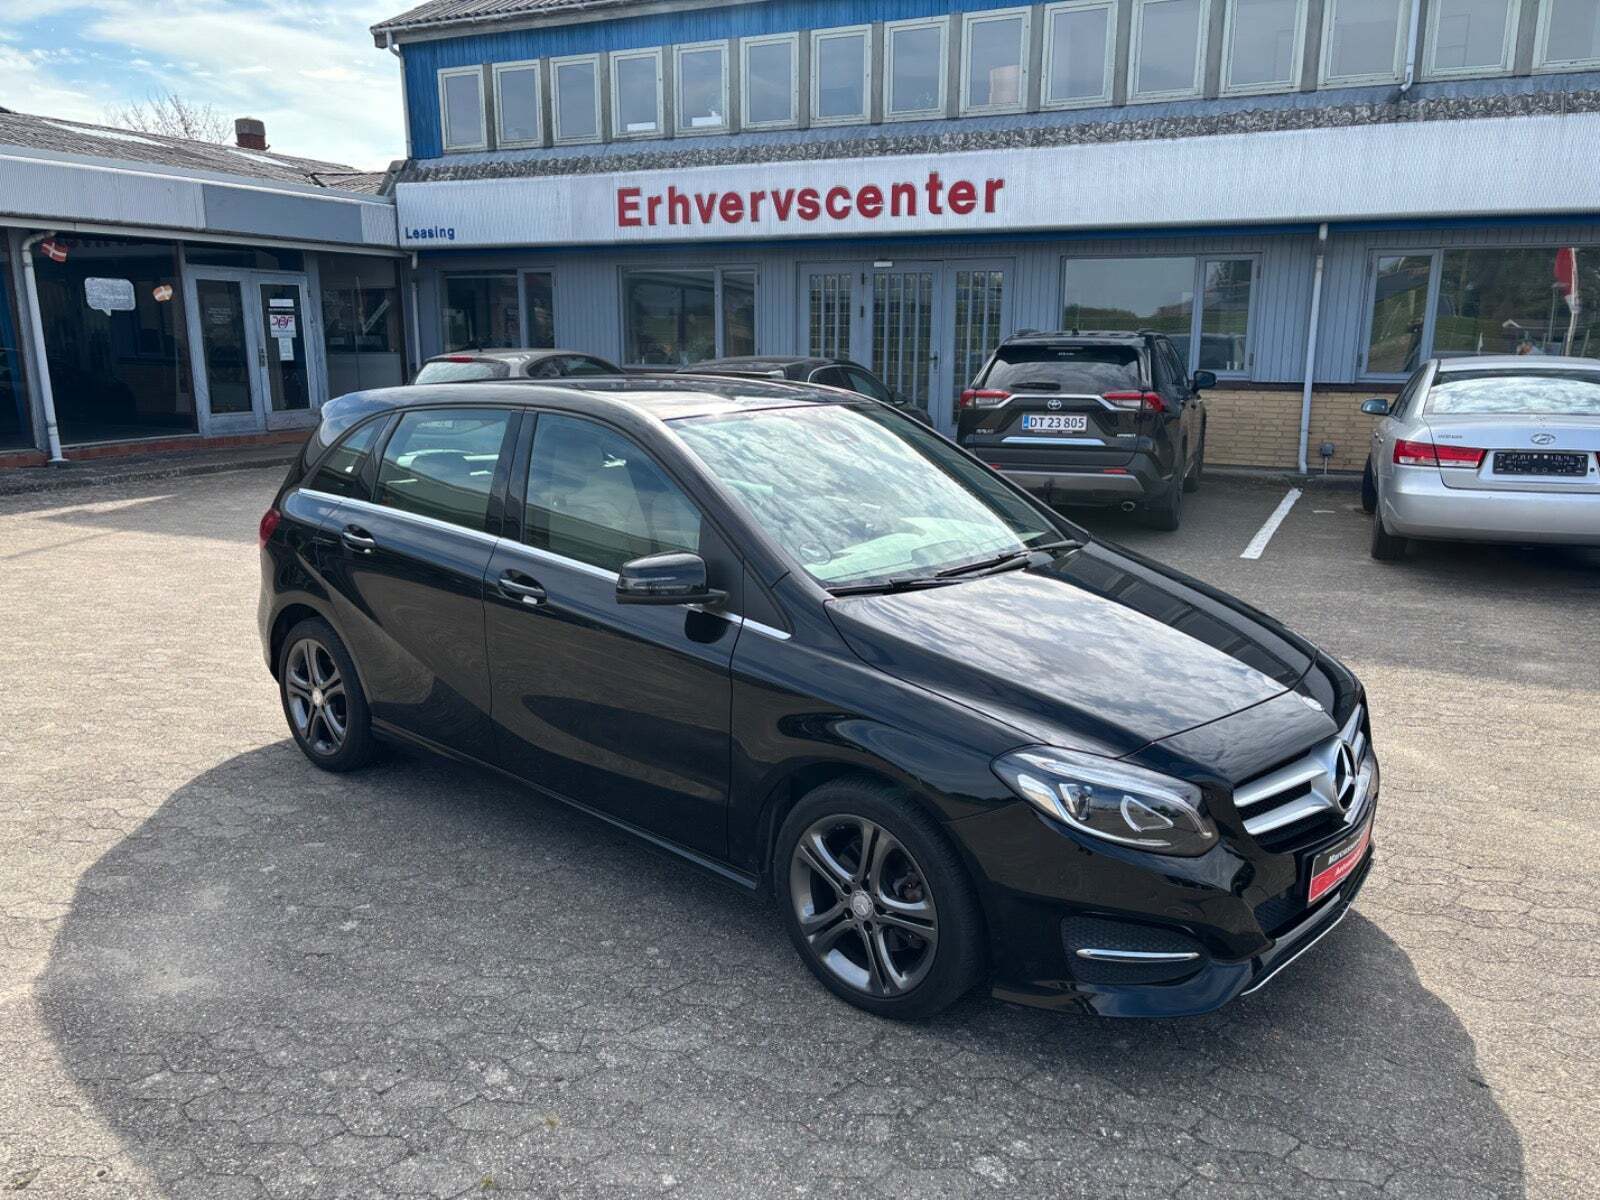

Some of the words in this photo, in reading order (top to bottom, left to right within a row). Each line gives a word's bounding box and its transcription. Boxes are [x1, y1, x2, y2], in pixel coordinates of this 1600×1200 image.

[617, 171, 1005, 227] Erhvervscenter
[405, 226, 455, 240] Leasing
[1030, 417, 1045, 427] DT
[1047, 417, 1061, 428] 23
[1063, 417, 1085, 428] 805
